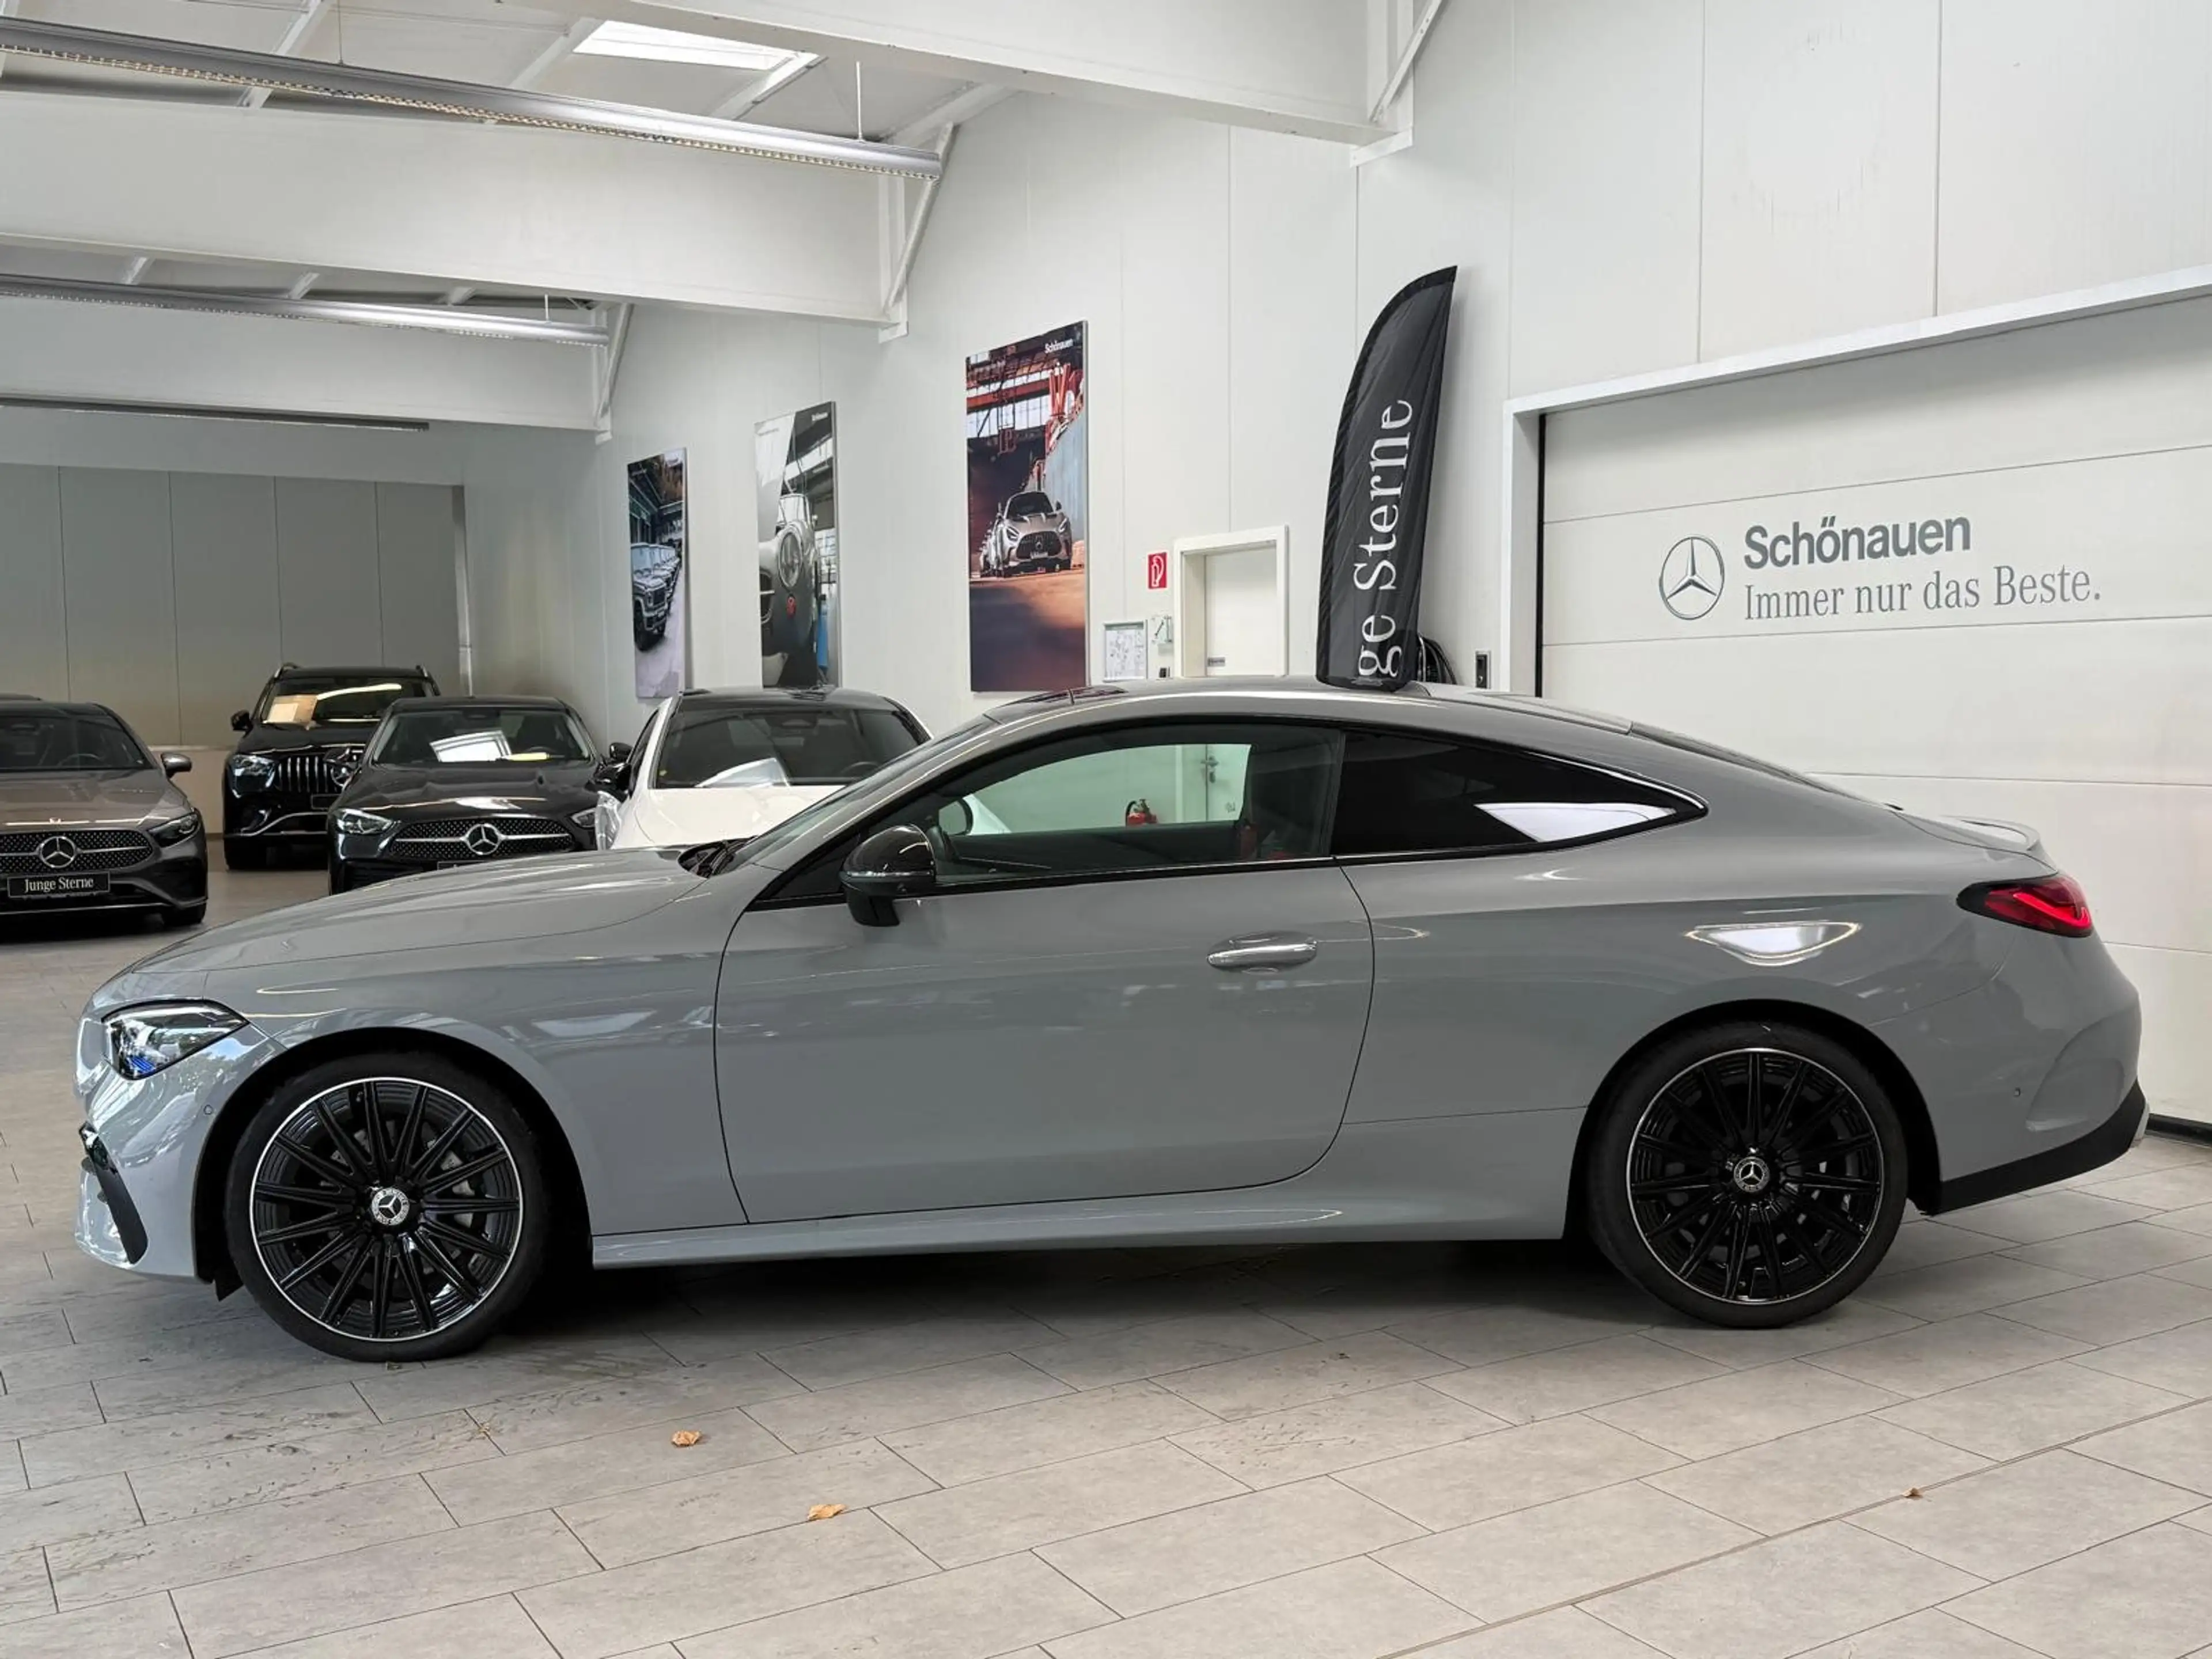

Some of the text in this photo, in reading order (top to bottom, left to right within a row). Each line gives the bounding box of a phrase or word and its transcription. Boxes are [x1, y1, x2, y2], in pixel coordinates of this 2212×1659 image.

[1353, 399, 1413, 590] Sterne
[1744, 515, 1971, 570] Schönauen
[1745, 564, 2101, 620] Immer nur das Beste.
[24, 876, 94, 892] Junge Sterne
